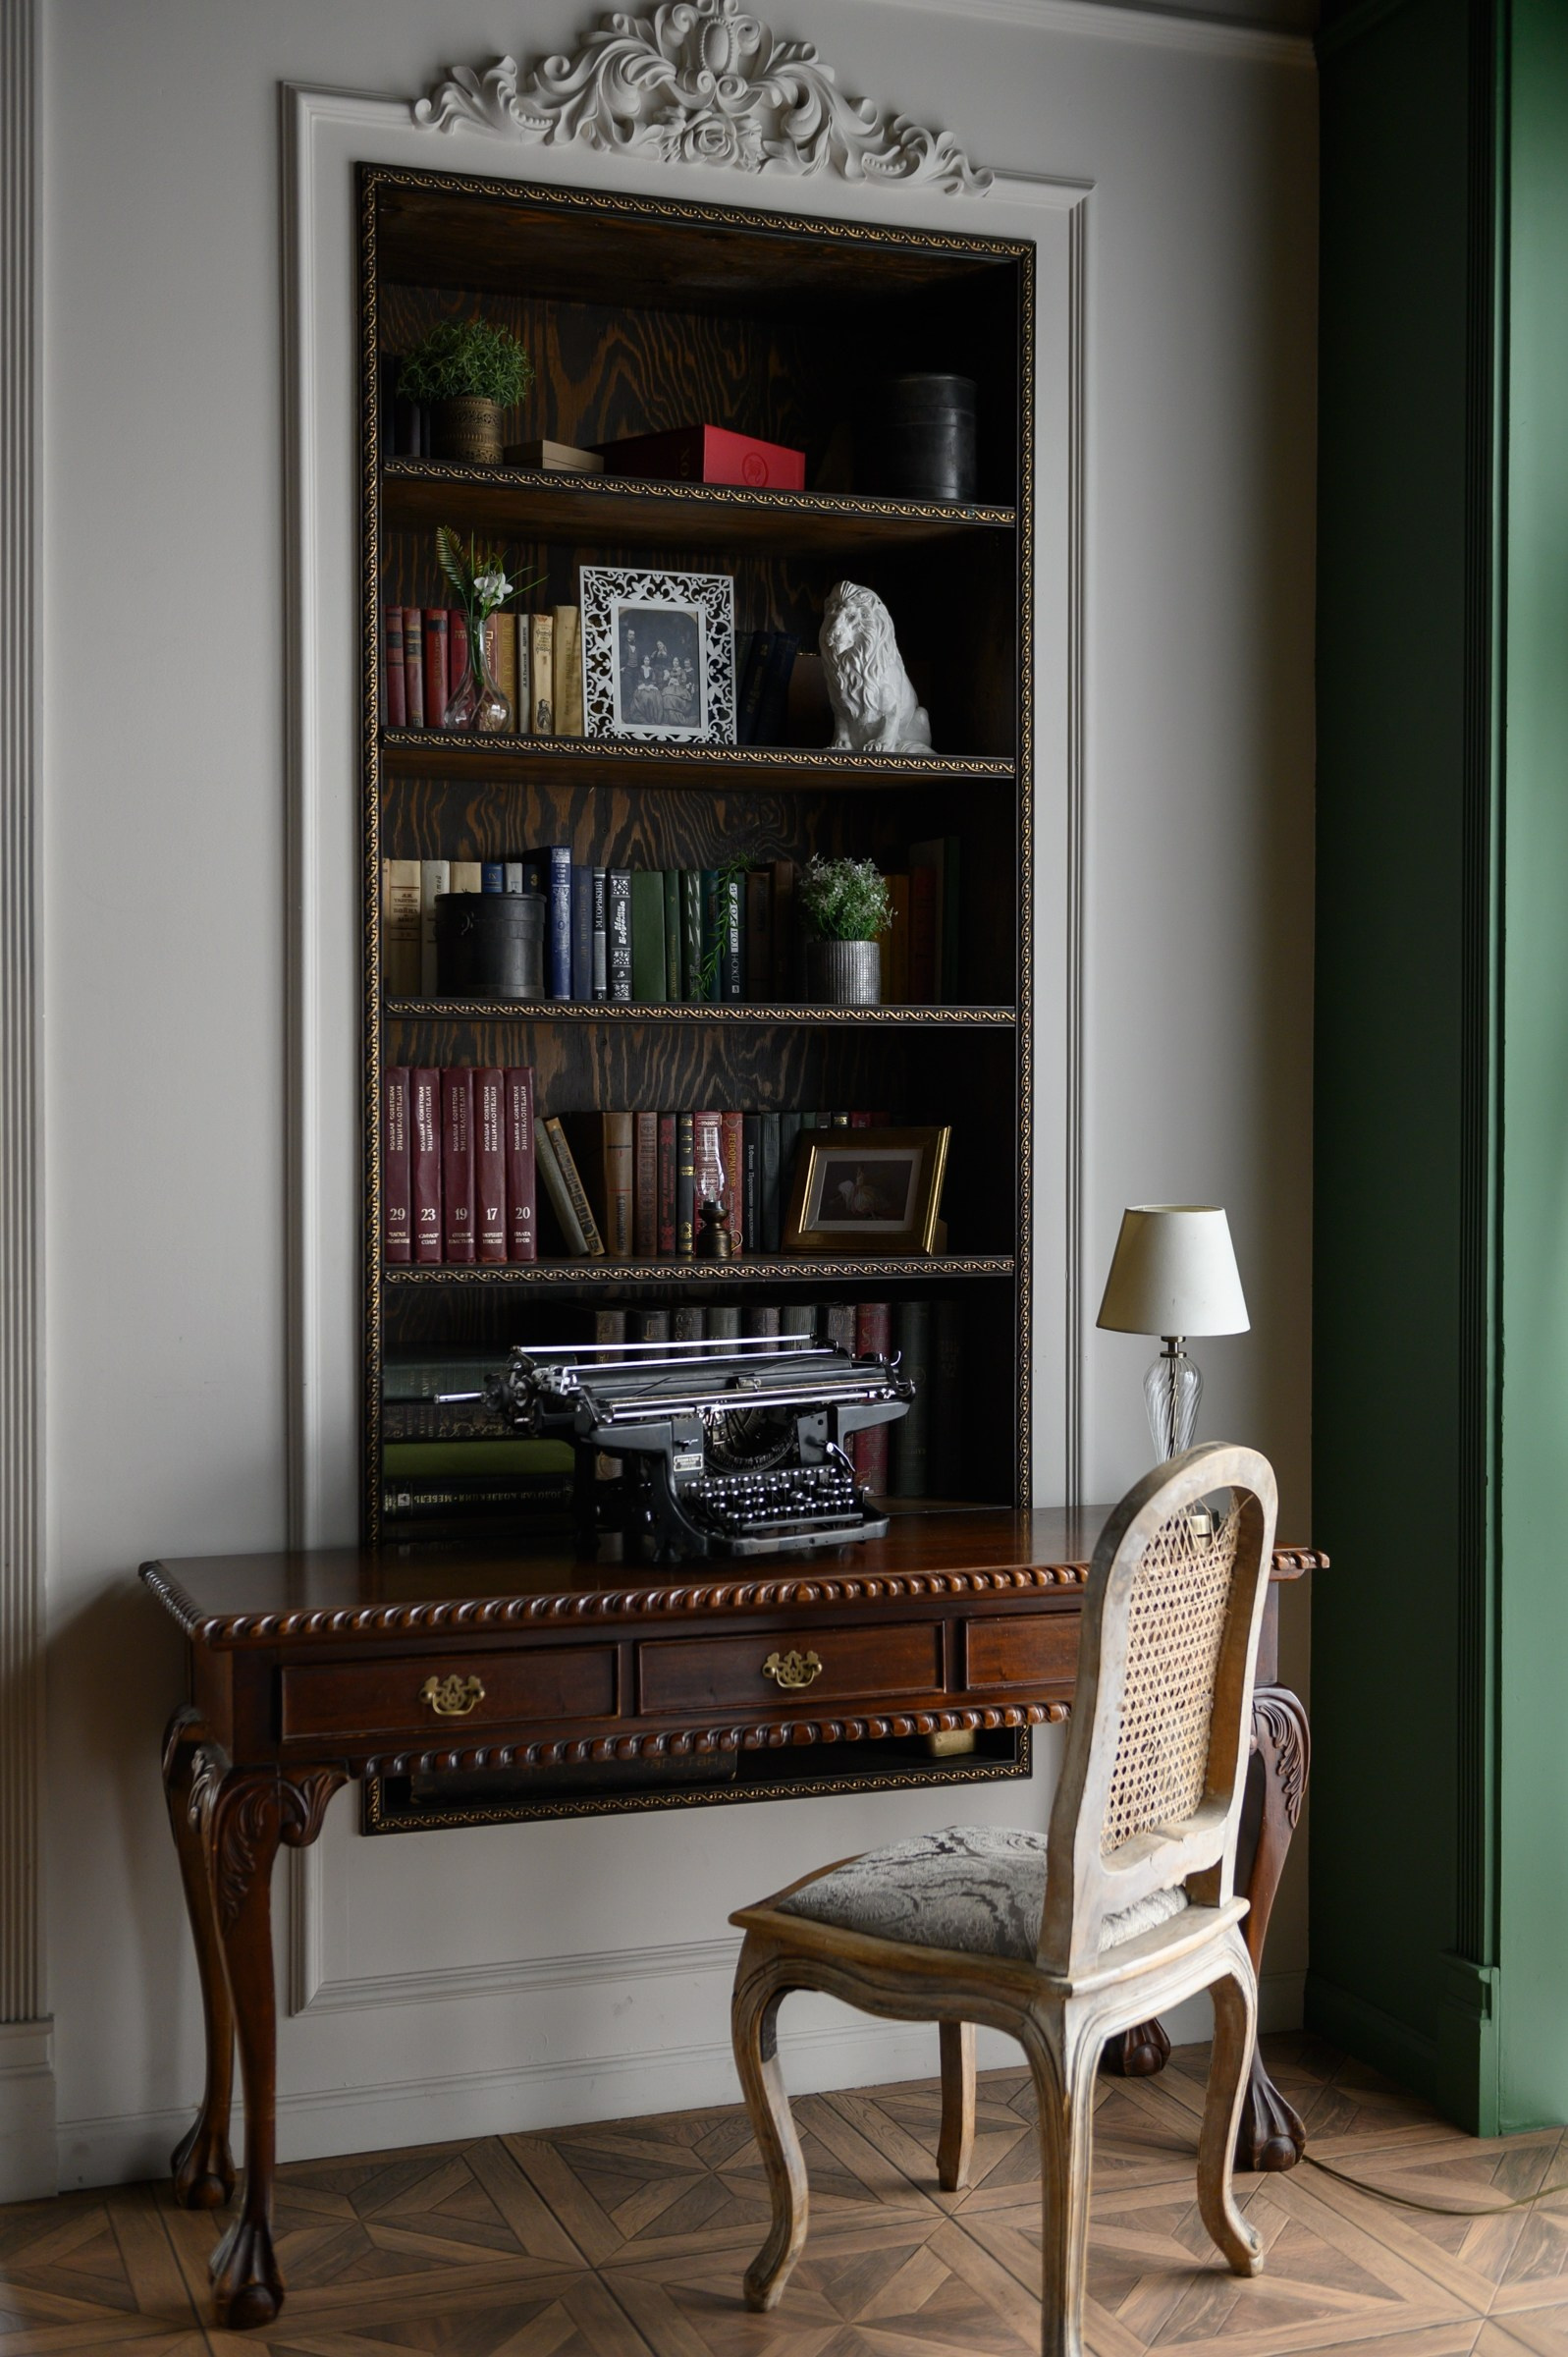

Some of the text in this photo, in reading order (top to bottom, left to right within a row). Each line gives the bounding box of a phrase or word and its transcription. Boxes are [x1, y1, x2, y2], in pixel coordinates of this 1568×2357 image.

[619, 901, 627, 944] Ефремов
[730, 954, 739, 983] ДЖОН
[728, 1133, 736, 1186] РЕФОРМАТОР
[389, 1207, 406, 1221] 29
[420, 1208, 436, 1222] 23
[455, 1207, 467, 1221] 19
[486, 1207, 498, 1221] 17
[514, 1206, 530, 1220] 20
[413, 1493, 453, 1504] МЕБЕЛЬ
[459, 1492, 516, 1502] КОЛЛЕКЦИЯ
